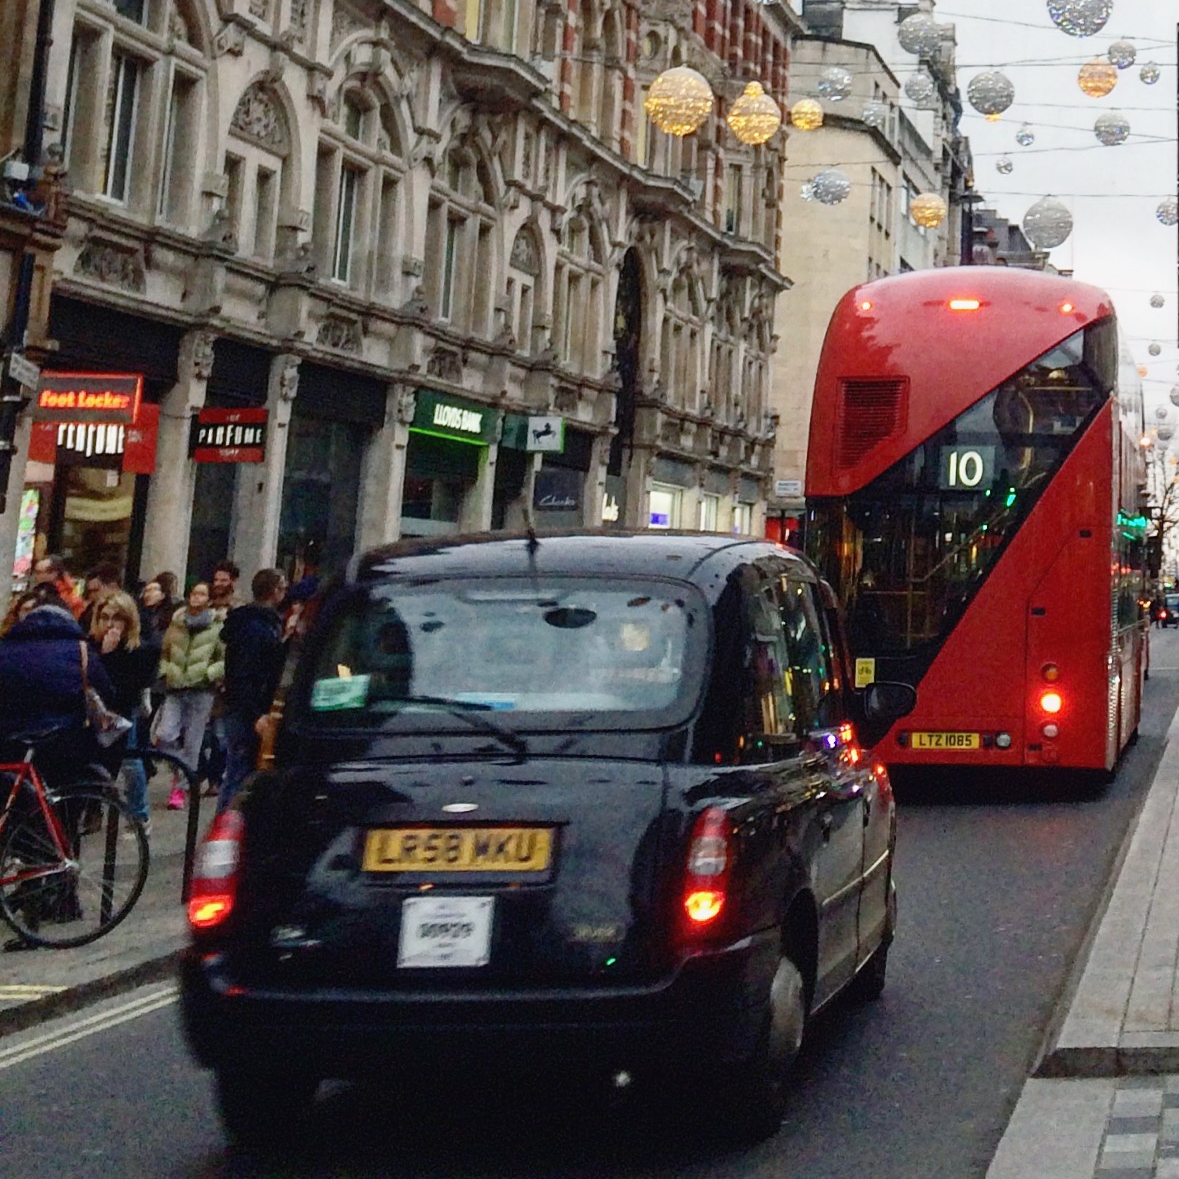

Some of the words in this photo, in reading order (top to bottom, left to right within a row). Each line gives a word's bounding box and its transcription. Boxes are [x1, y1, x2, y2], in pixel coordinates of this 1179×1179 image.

[39, 390, 75, 409] Foot
[76, 391, 130, 409] Locker
[949, 451, 983, 486] 10
